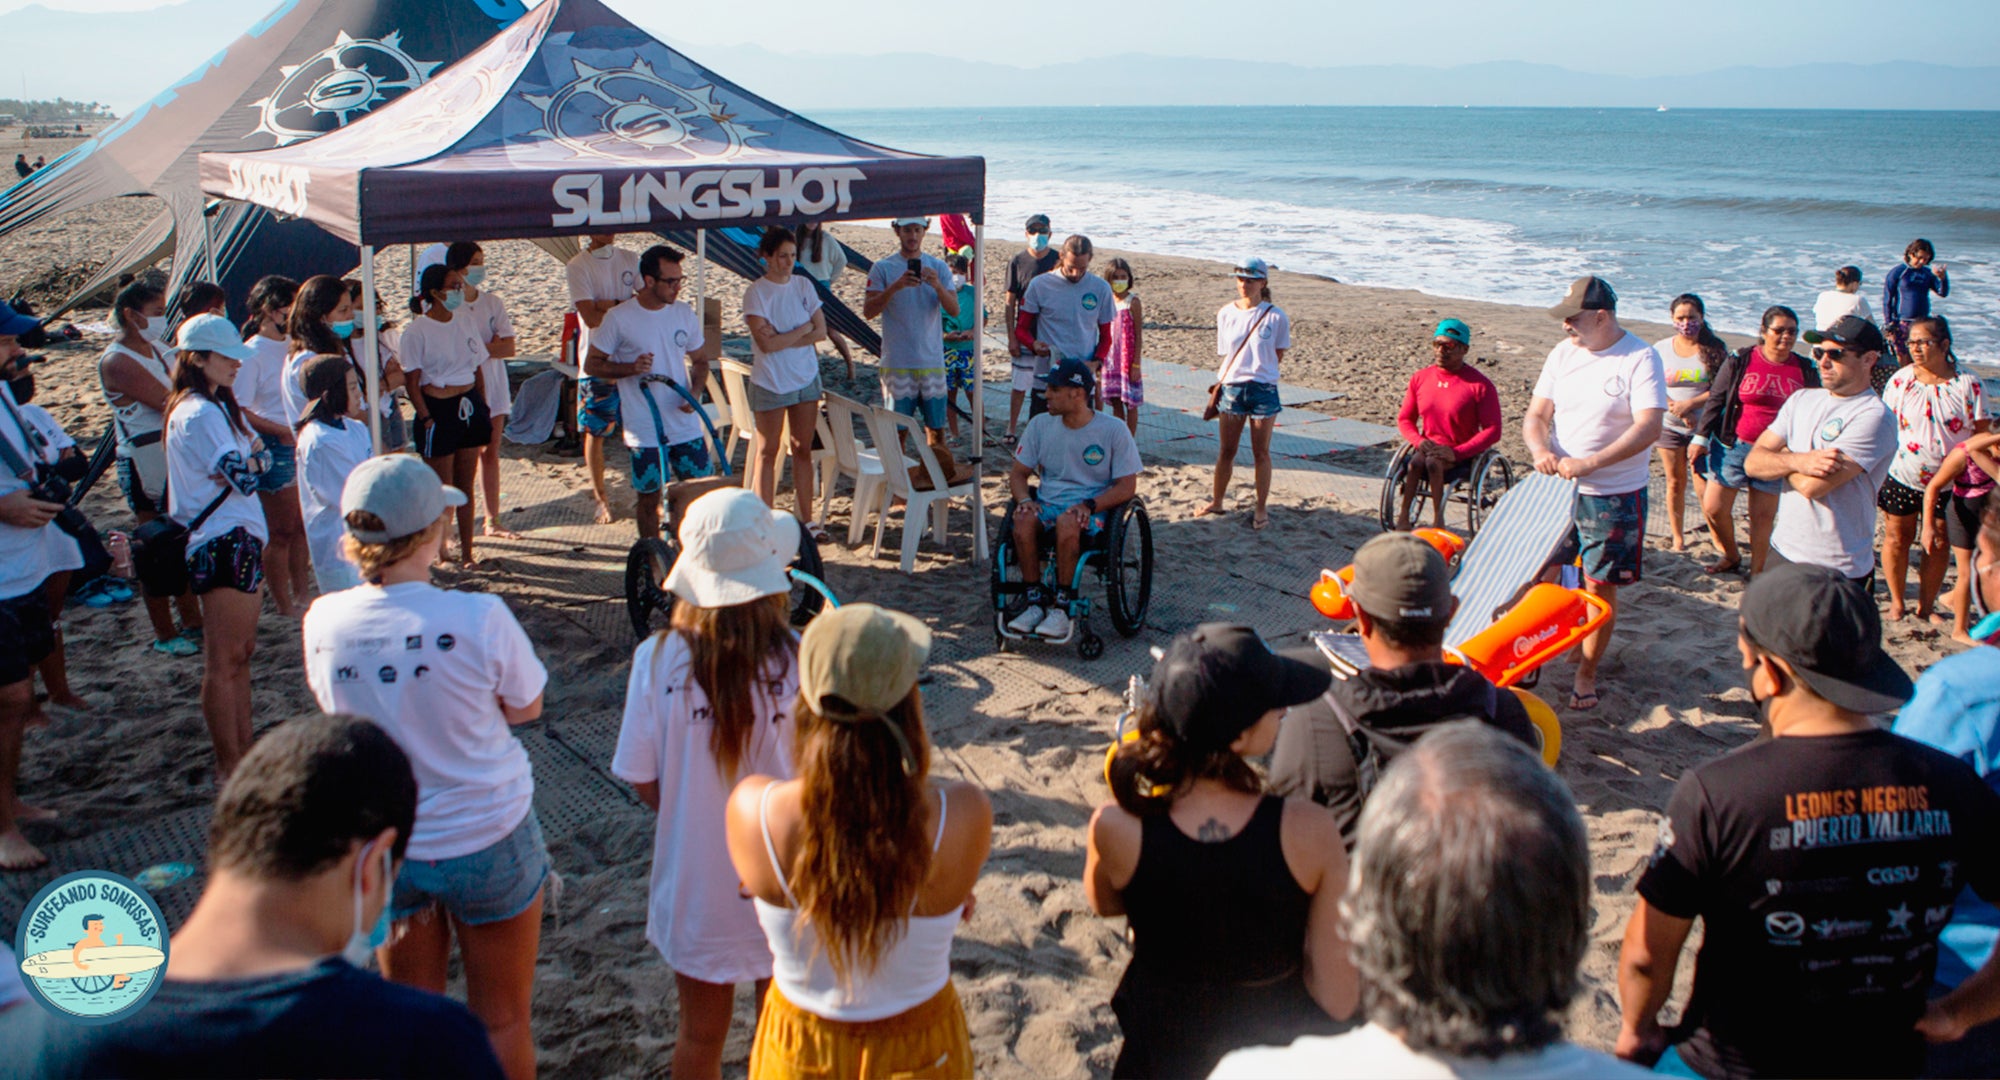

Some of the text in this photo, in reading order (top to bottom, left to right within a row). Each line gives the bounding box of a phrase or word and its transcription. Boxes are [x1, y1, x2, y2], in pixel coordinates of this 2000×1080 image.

[225, 159, 311, 218] SLINGSHOT
[551, 167, 867, 227] SLINGSHOT
[1785, 785, 1928, 822] LEONES NEGROS
[1793, 814, 1861, 848] PUERTO
[1867, 809, 1951, 838] VALLARTA
